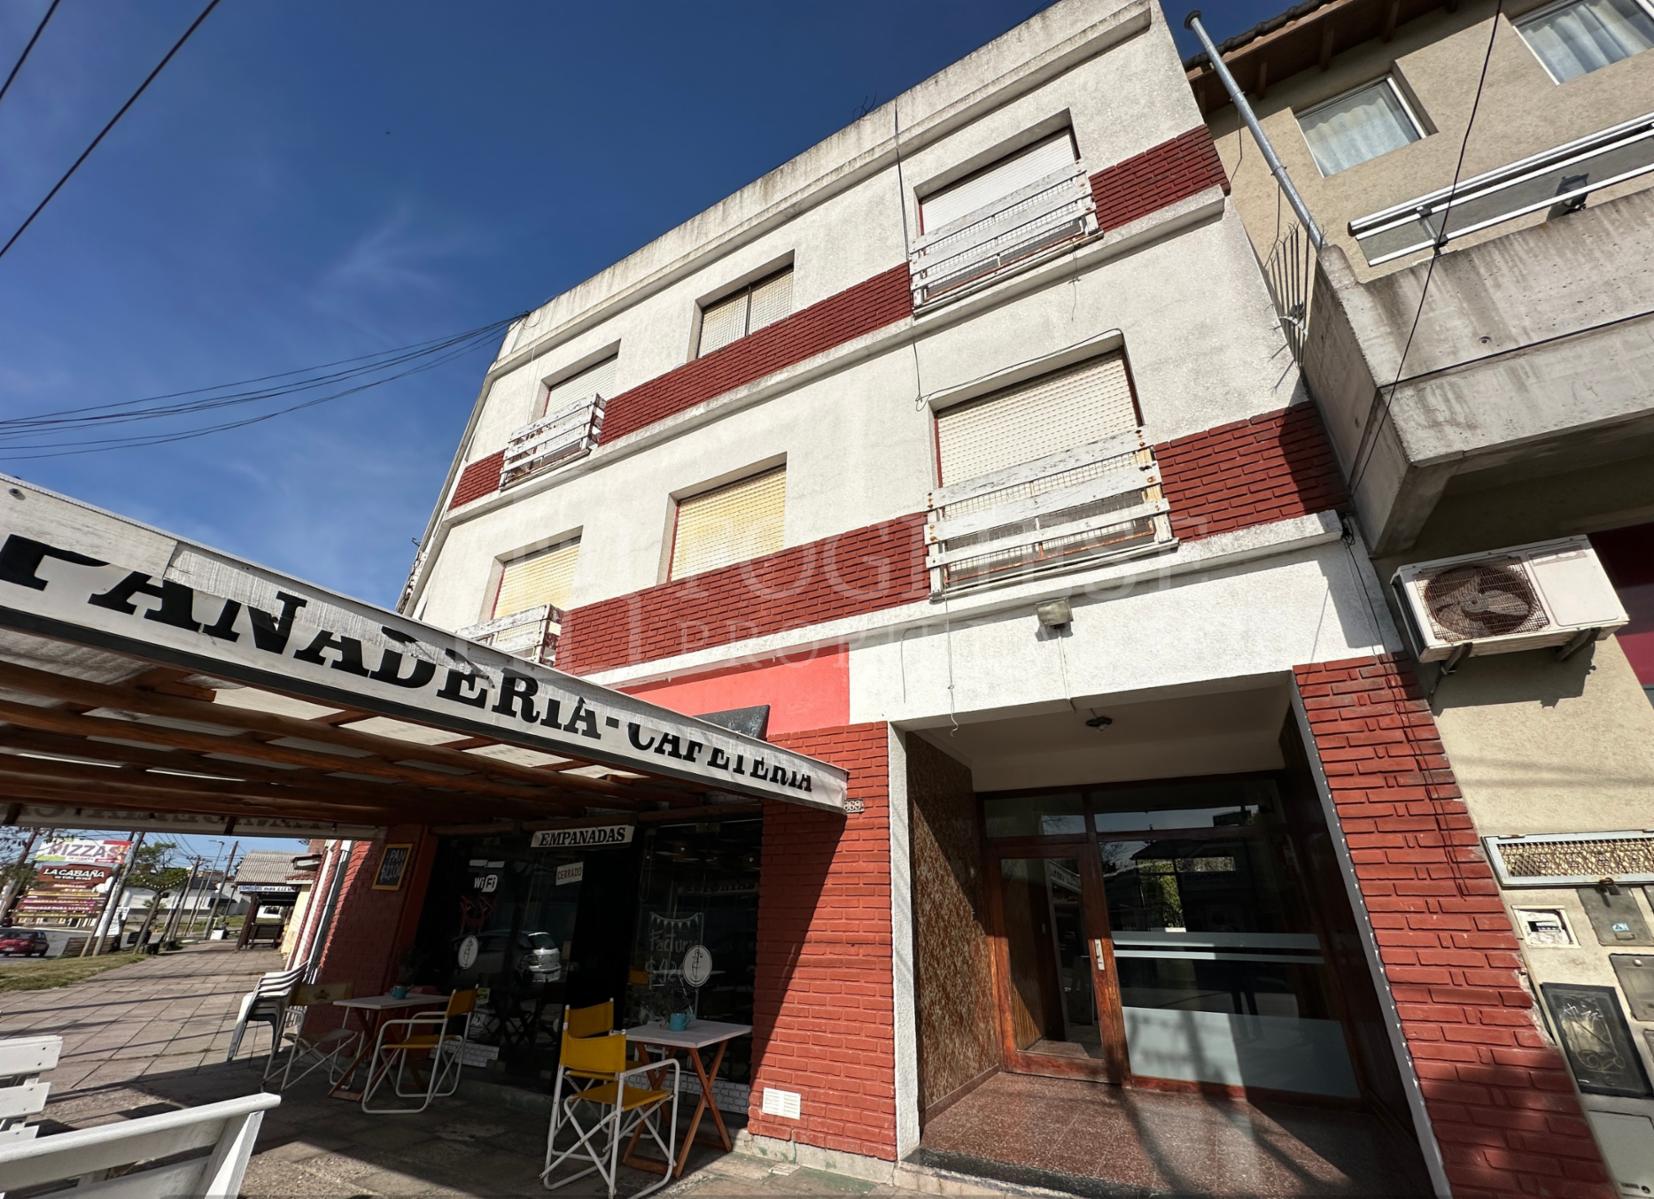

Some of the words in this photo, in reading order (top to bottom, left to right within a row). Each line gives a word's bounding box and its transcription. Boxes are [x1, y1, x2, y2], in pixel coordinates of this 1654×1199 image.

[539, 827, 626, 846] EMPANADAS
[48, 844, 118, 858] PIZZAS
[58, 868, 105, 878] CABAÑA
[558, 866, 582, 880] CERRADO
